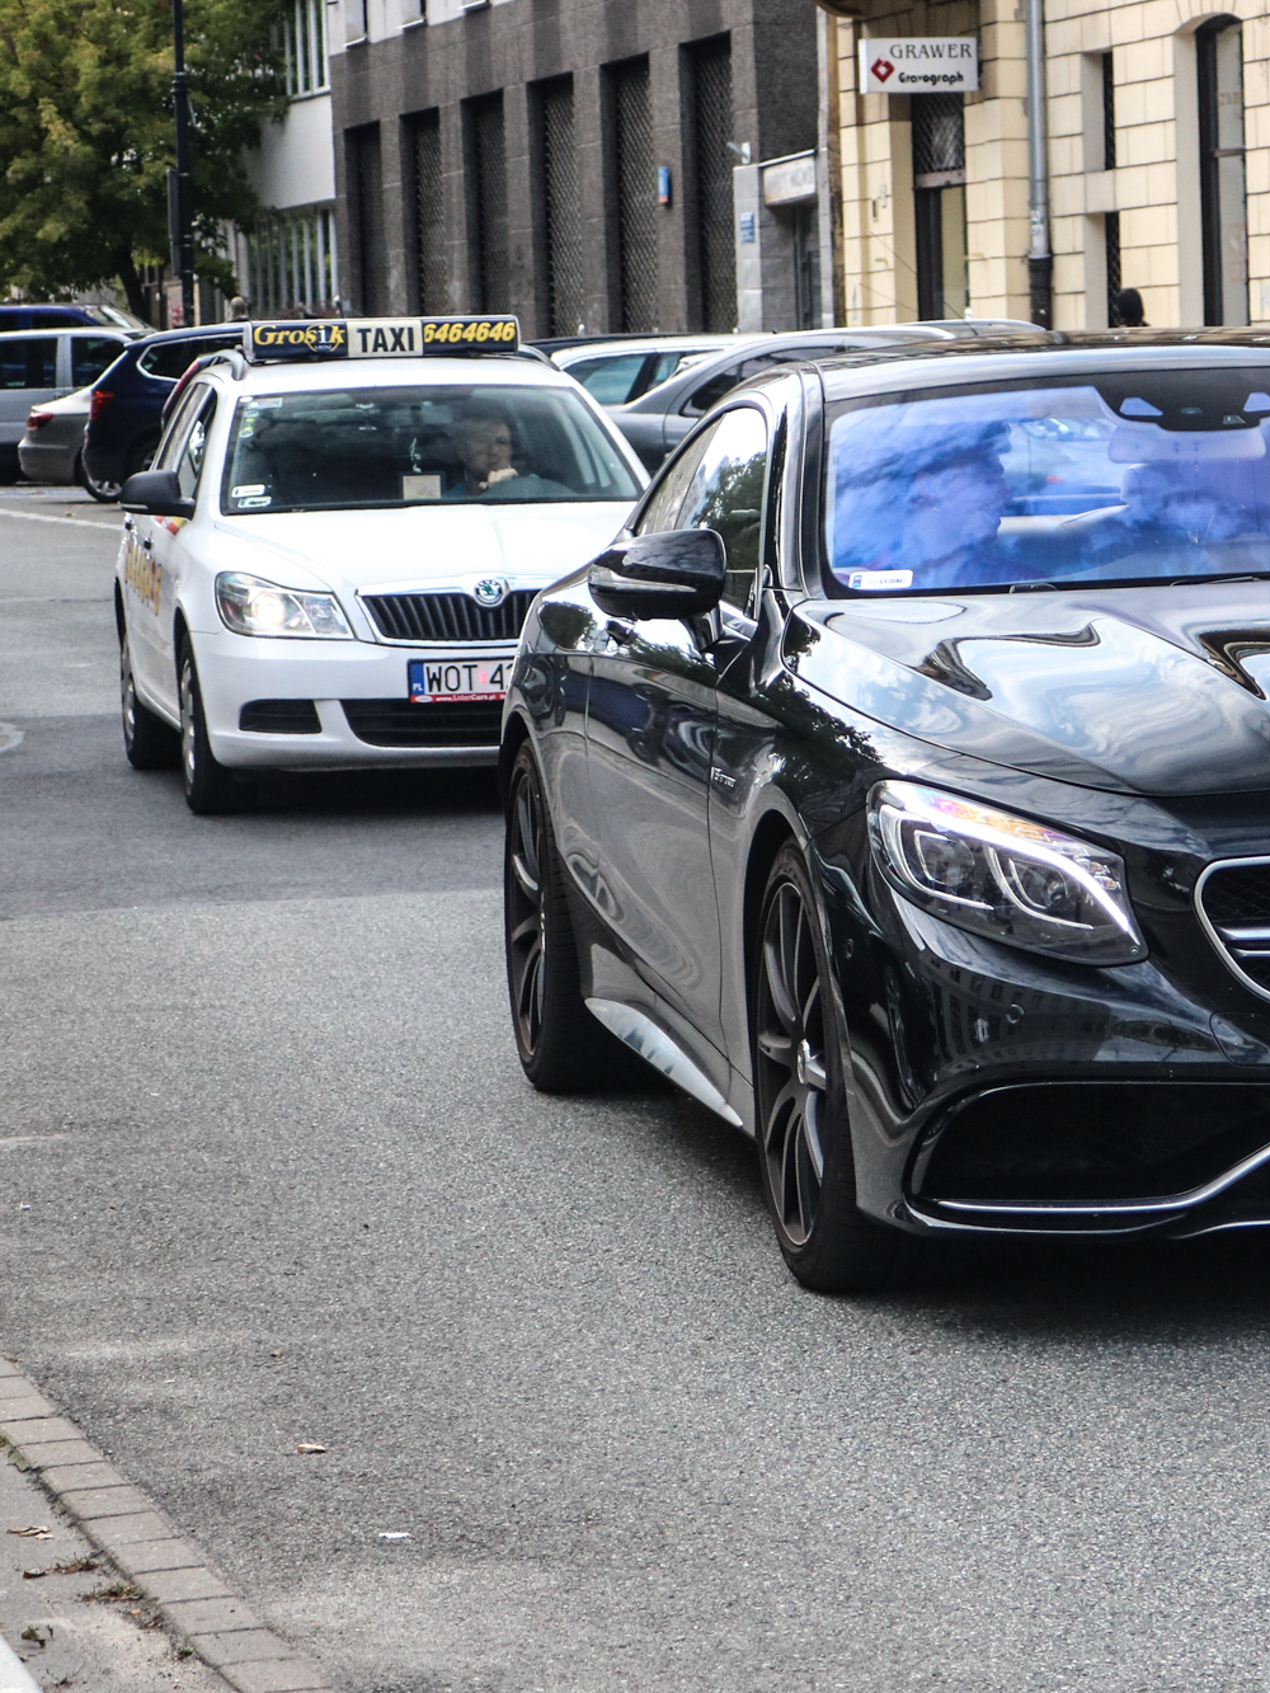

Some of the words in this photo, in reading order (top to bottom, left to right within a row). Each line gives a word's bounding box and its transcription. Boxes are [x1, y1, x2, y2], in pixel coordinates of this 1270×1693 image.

[889, 43, 973, 59] GRAWER
[253, 323, 345, 346] Grosik
[357, 326, 414, 352] TAXI
[424, 322, 516, 343] 6464646
[413, 682, 424, 691] PL
[426, 664, 478, 692] WOT
[489, 663, 514, 690] 4
